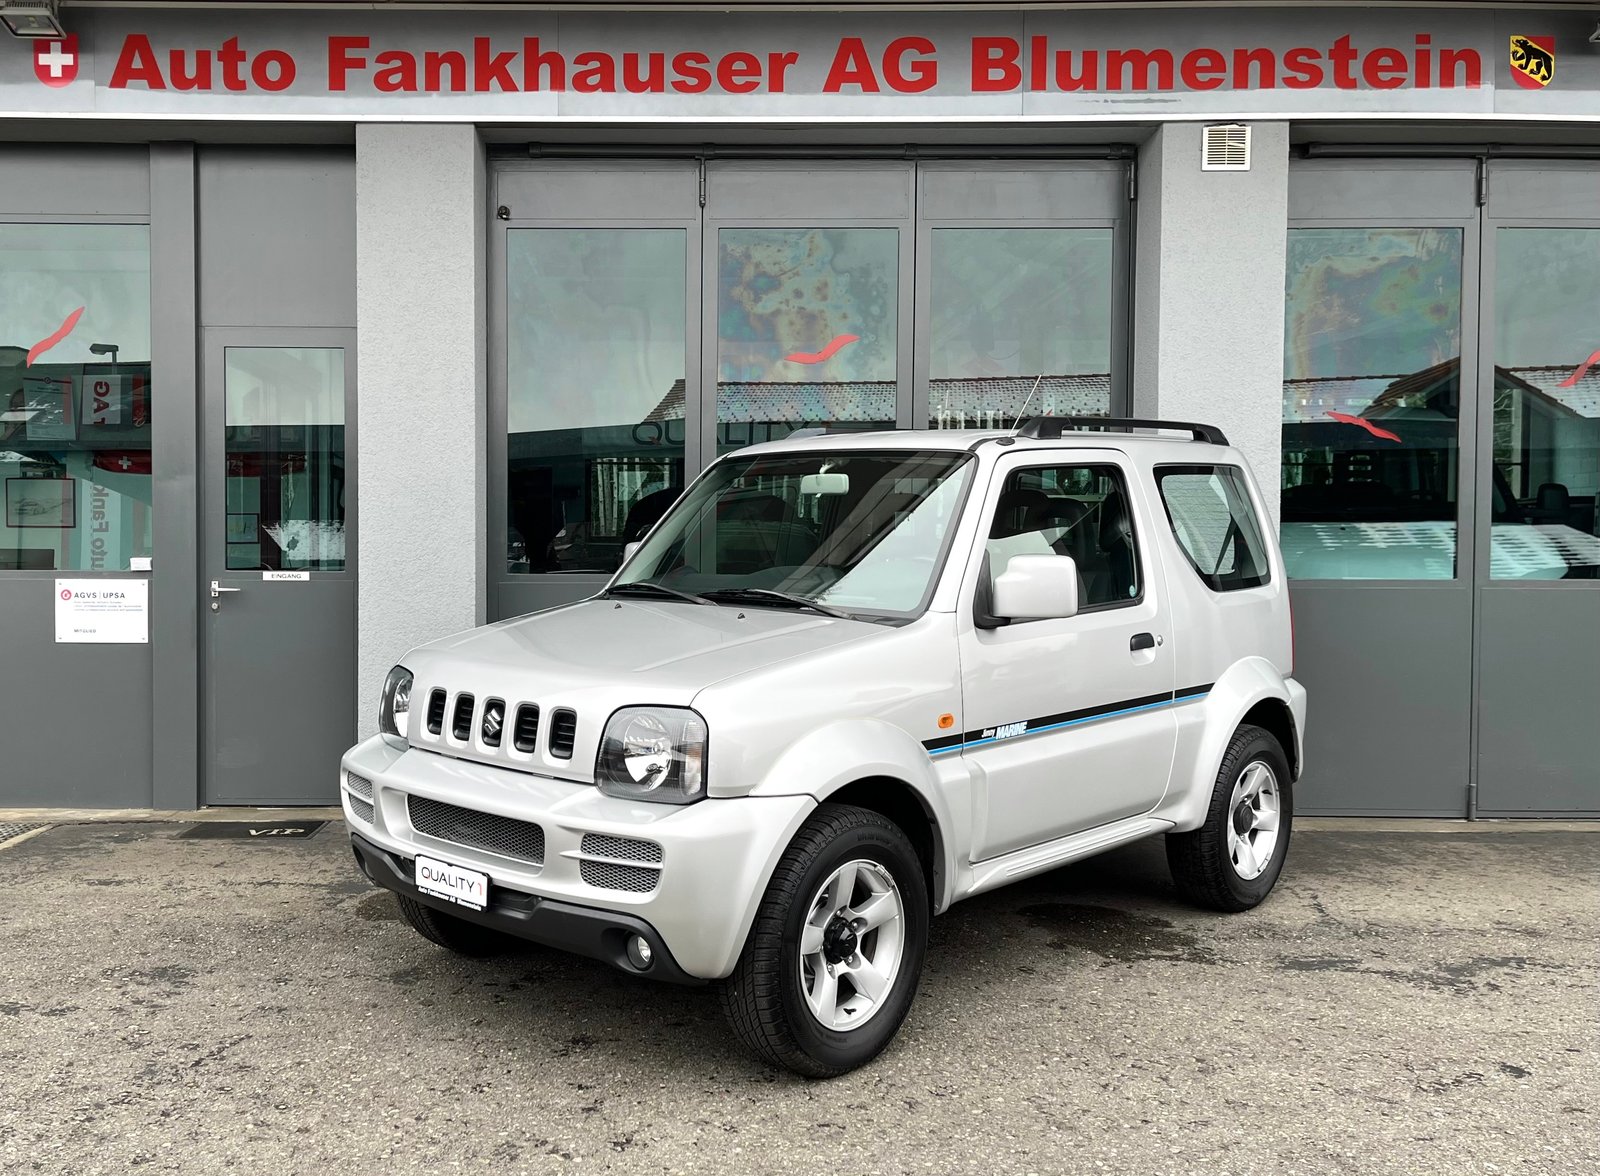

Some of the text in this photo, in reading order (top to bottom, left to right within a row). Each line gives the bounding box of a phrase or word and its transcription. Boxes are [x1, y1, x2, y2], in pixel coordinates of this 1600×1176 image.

[111, 35, 1481, 94] Auto Fankhauser AG Blumenstein
[996, 721, 1028, 740] MARINE
[249, 828, 305, 836] VIP
